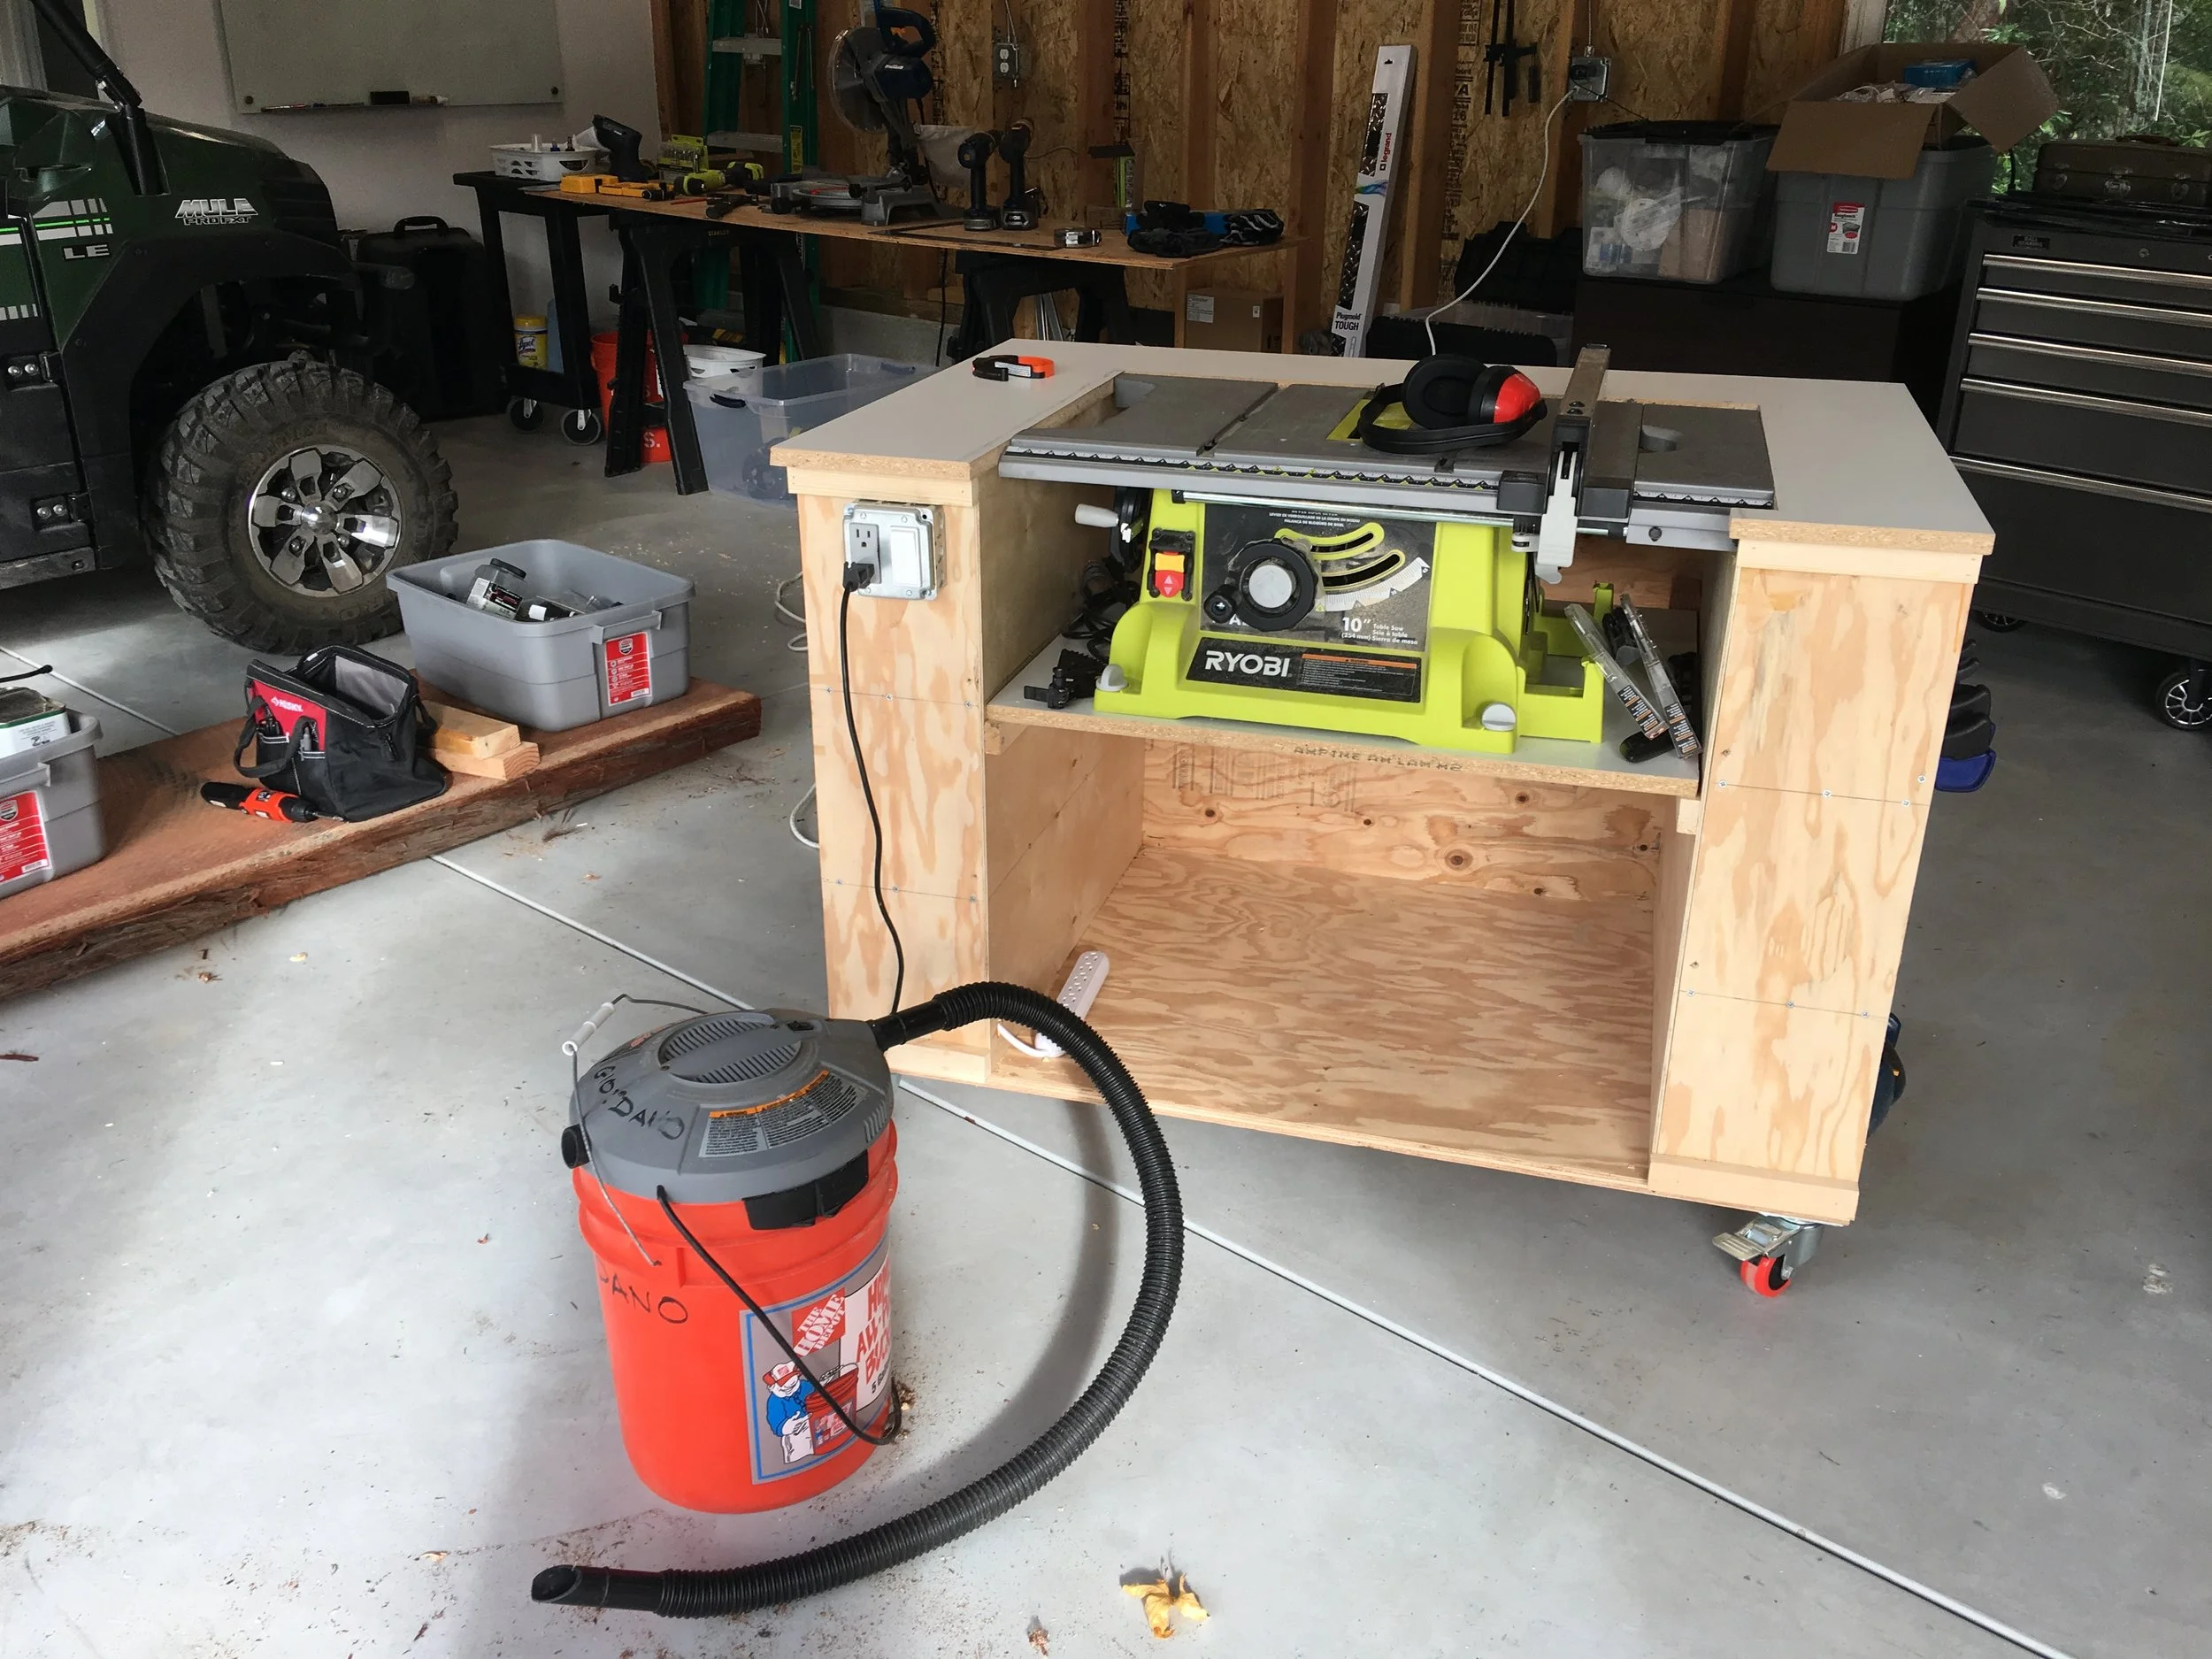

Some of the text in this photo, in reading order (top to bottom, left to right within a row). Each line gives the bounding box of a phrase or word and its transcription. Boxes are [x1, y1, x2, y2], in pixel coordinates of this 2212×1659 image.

[1381, 133, 1392, 162] legrand
[175, 198, 258, 218] MULE
[184, 216, 219, 226] PRO
[64, 244, 110, 259] LE
[1335, 321, 1360, 331] TOUGH
[1204, 649, 1291, 678] RYOBI
[793, 1294, 845, 1356] HOME
[797, 1307, 822, 1332] THE
[813, 1306, 846, 1349] DEPOT
